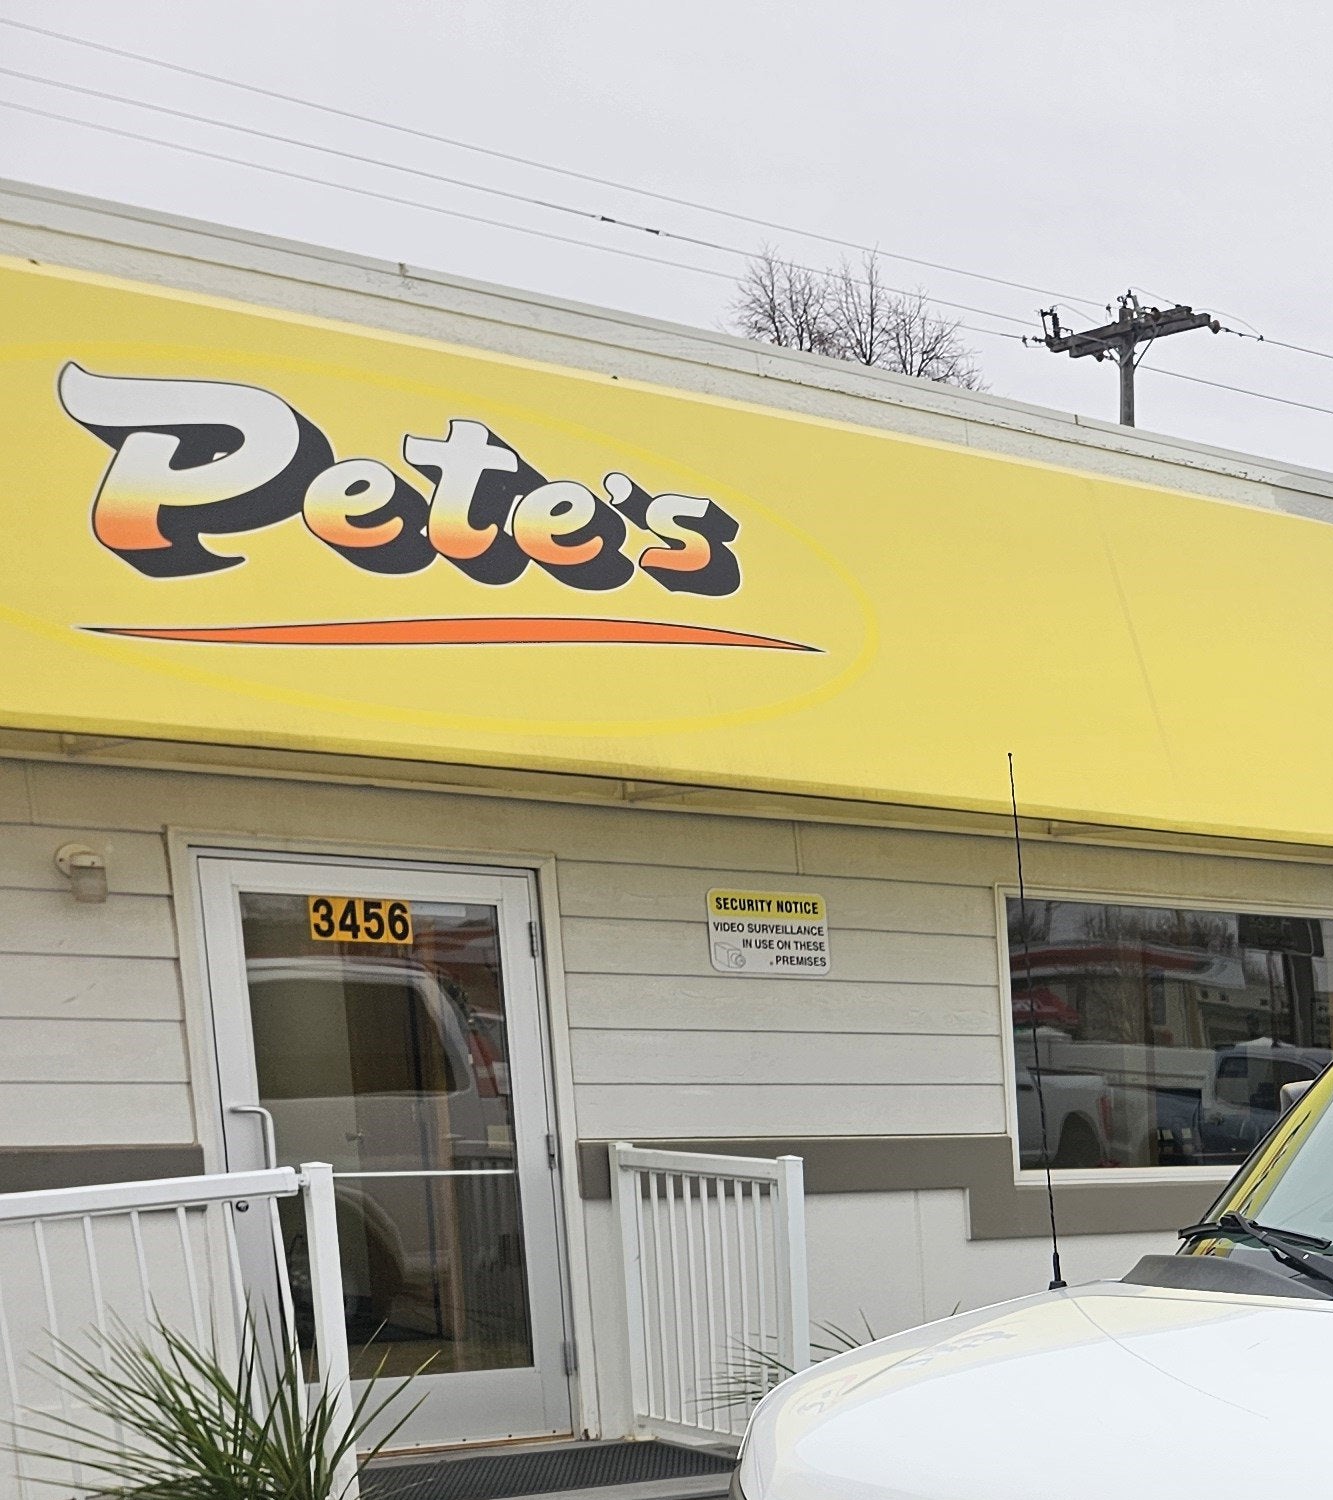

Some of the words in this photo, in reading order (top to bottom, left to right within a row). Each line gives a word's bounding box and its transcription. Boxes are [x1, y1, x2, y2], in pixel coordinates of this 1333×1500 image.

[57, 361, 740, 592] Pete's
[715, 897, 772, 913] SECURITY
[776, 900, 819, 915] NOTICE
[312, 898, 410, 941] 3456
[713, 922, 745, 933] VIDEO
[747, 923, 825, 936] SURVEILLANCE
[742, 938, 753, 949] IN
[755, 939, 775, 950] USE
[777, 940, 791, 951] ON
[793, 941, 826, 952] THESE
[775, 955, 827, 967] PREMISES
